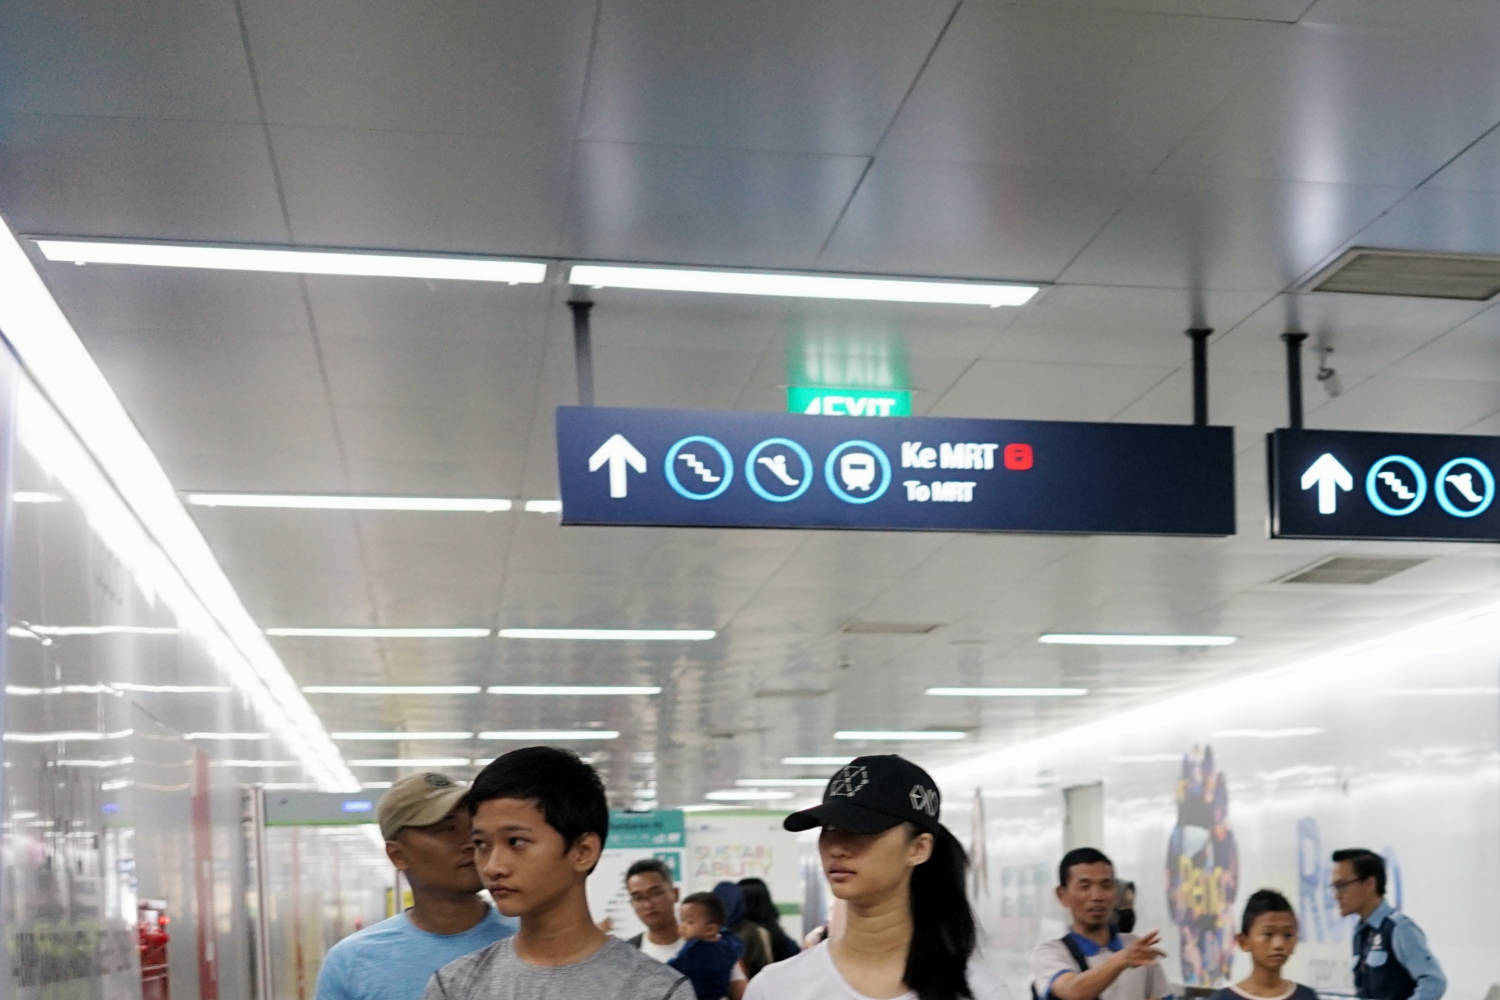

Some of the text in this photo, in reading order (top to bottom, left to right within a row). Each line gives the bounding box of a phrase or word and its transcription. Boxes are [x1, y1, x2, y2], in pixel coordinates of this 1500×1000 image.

[901, 441, 999, 470] Ke MRT
[902, 480, 977, 502] To MRT
